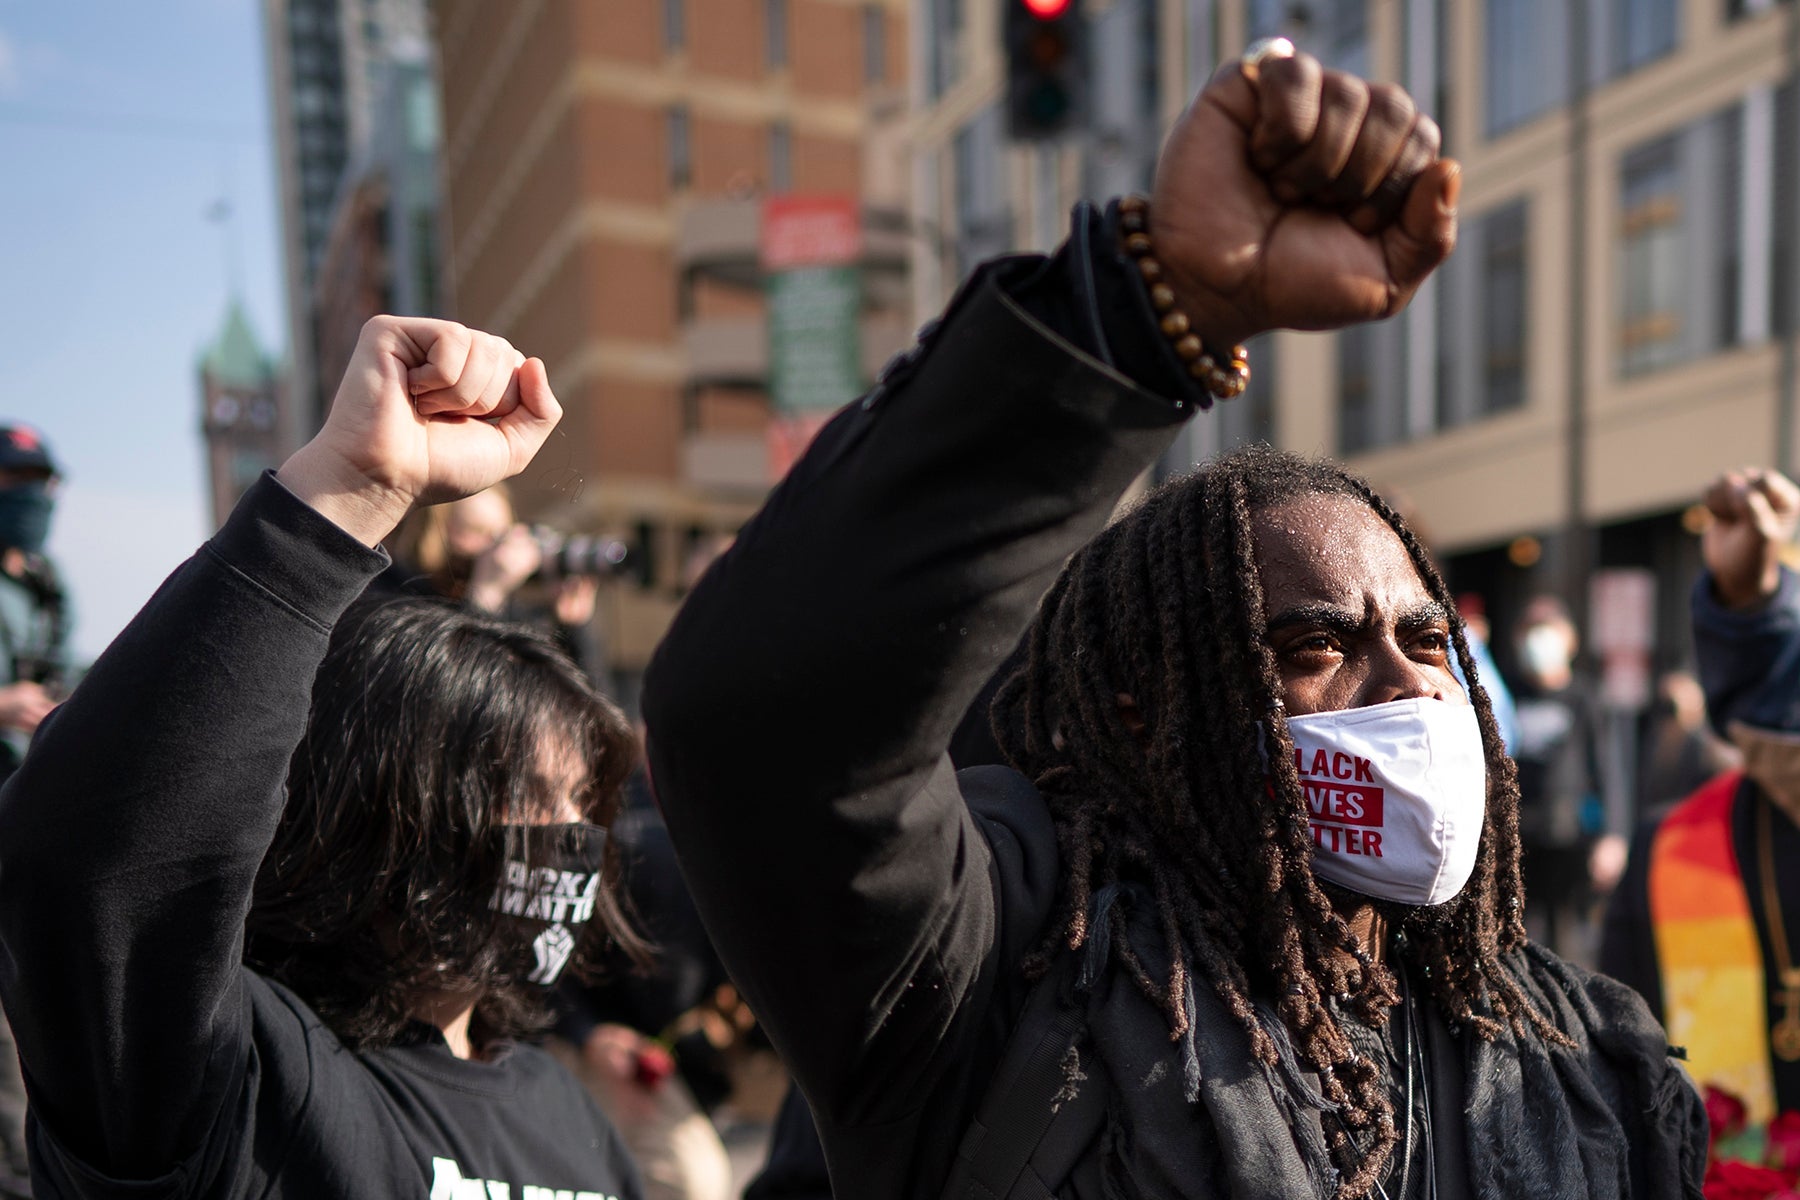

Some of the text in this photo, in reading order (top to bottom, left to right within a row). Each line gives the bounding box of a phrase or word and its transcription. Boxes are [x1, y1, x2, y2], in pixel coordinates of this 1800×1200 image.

[1295, 748, 1375, 783] LACK
[1300, 785, 1364, 819] VES
[1311, 824, 1383, 858] TTER
